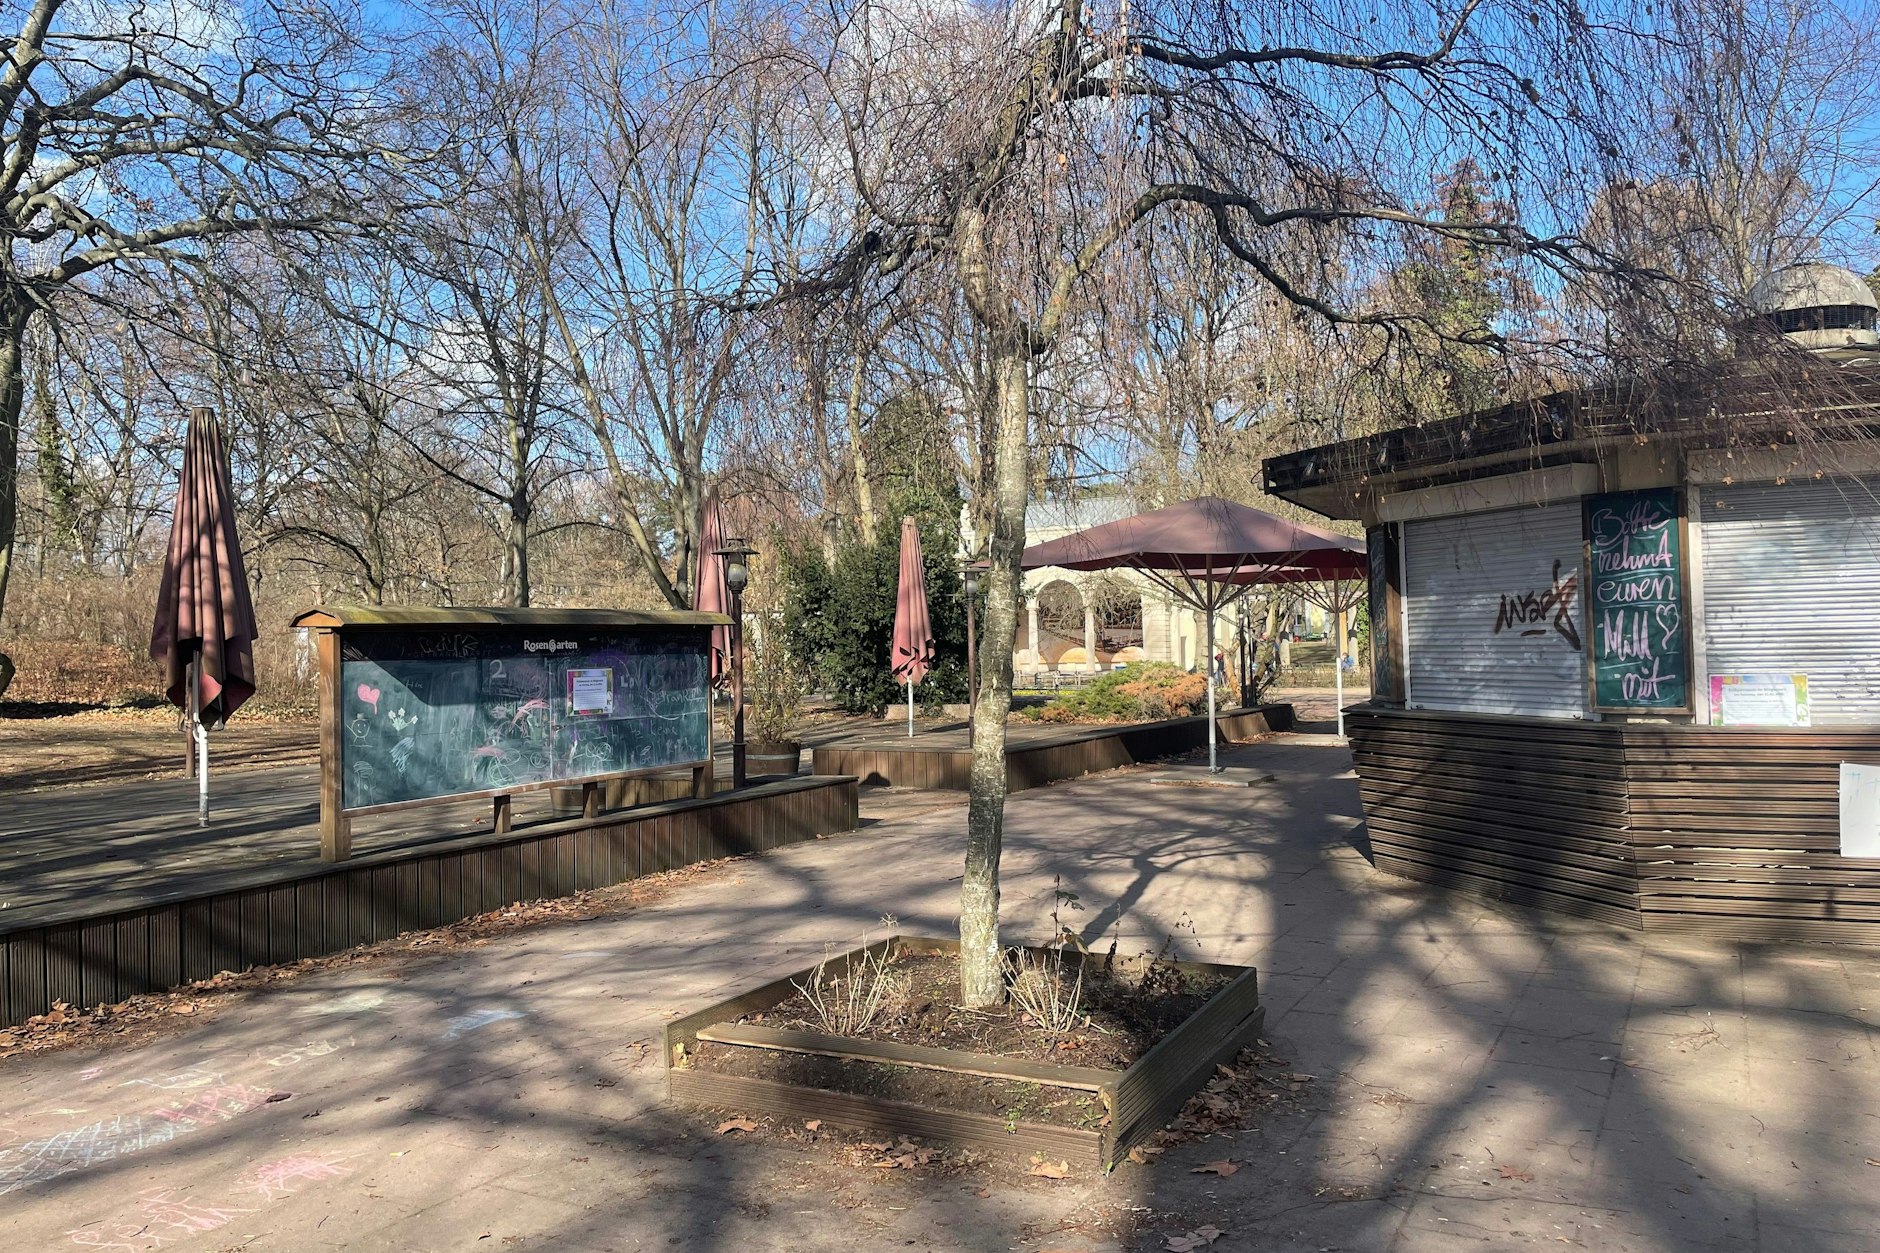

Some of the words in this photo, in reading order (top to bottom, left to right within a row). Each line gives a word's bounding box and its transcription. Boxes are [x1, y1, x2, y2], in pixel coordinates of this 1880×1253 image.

[1597, 575, 1676, 603] euren
[523, 639, 578, 653] RosenGarten
[1621, 656, 1676, 700] mit
